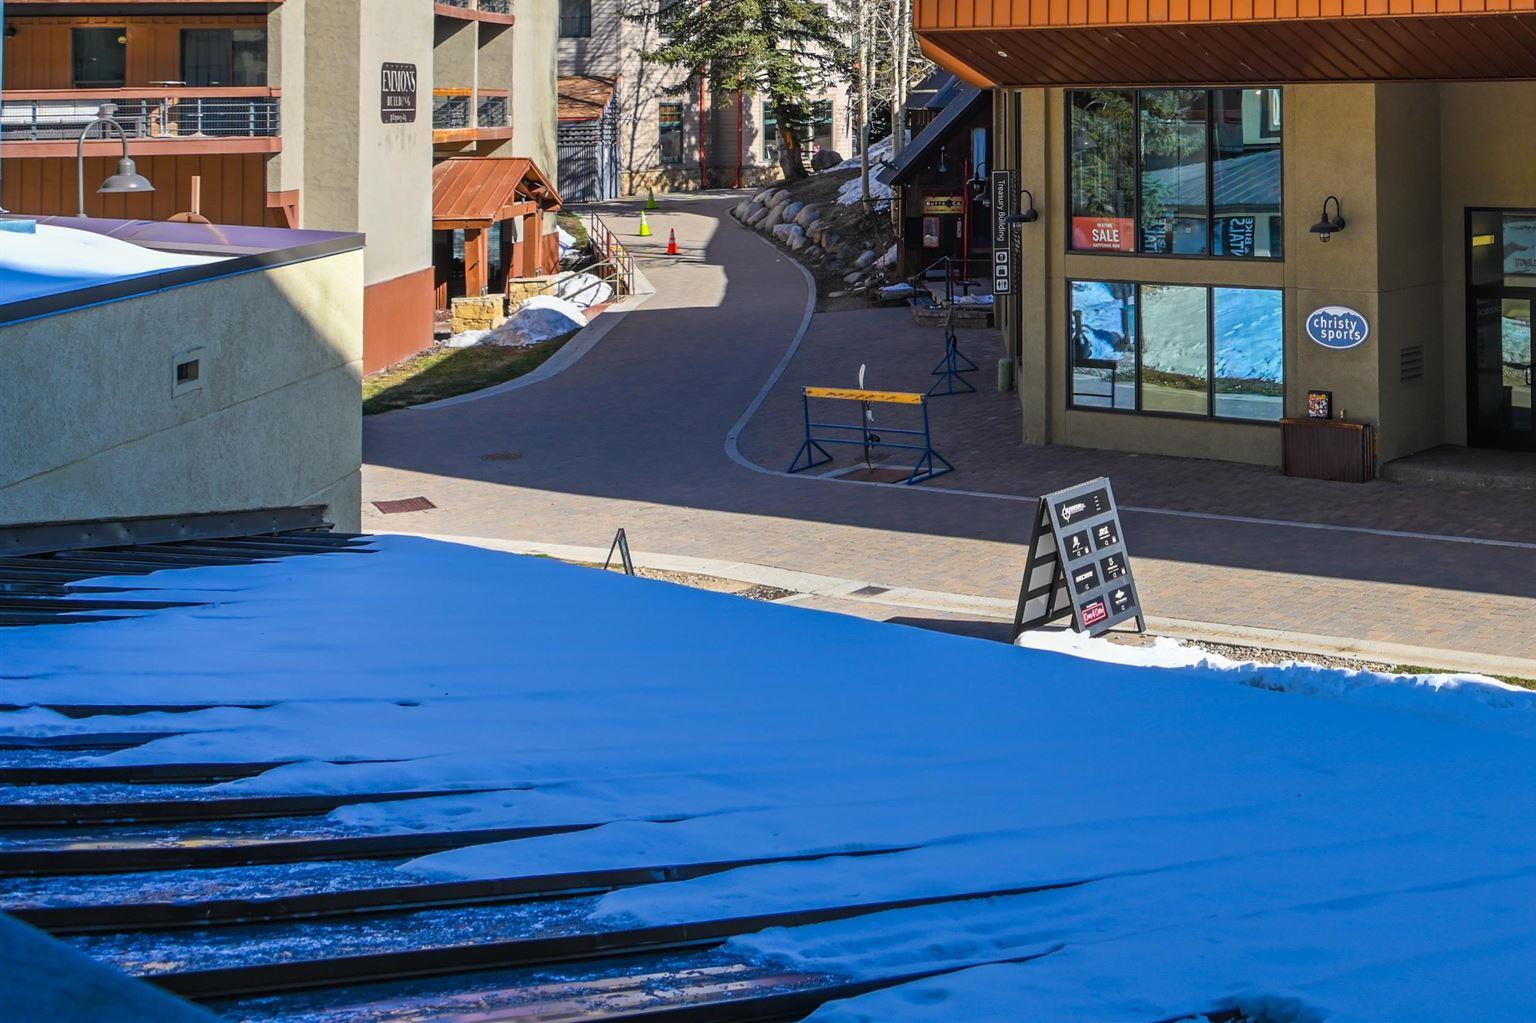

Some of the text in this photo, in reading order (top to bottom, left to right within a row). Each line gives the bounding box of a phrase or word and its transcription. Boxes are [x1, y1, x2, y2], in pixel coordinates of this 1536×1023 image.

[382, 70, 416, 93] EMMONS
[997, 180, 1006, 211] Treasury
[1092, 228, 1120, 243] SALE
[1314, 317, 1357, 331] christy
[1321, 328, 1361, 342] sports
